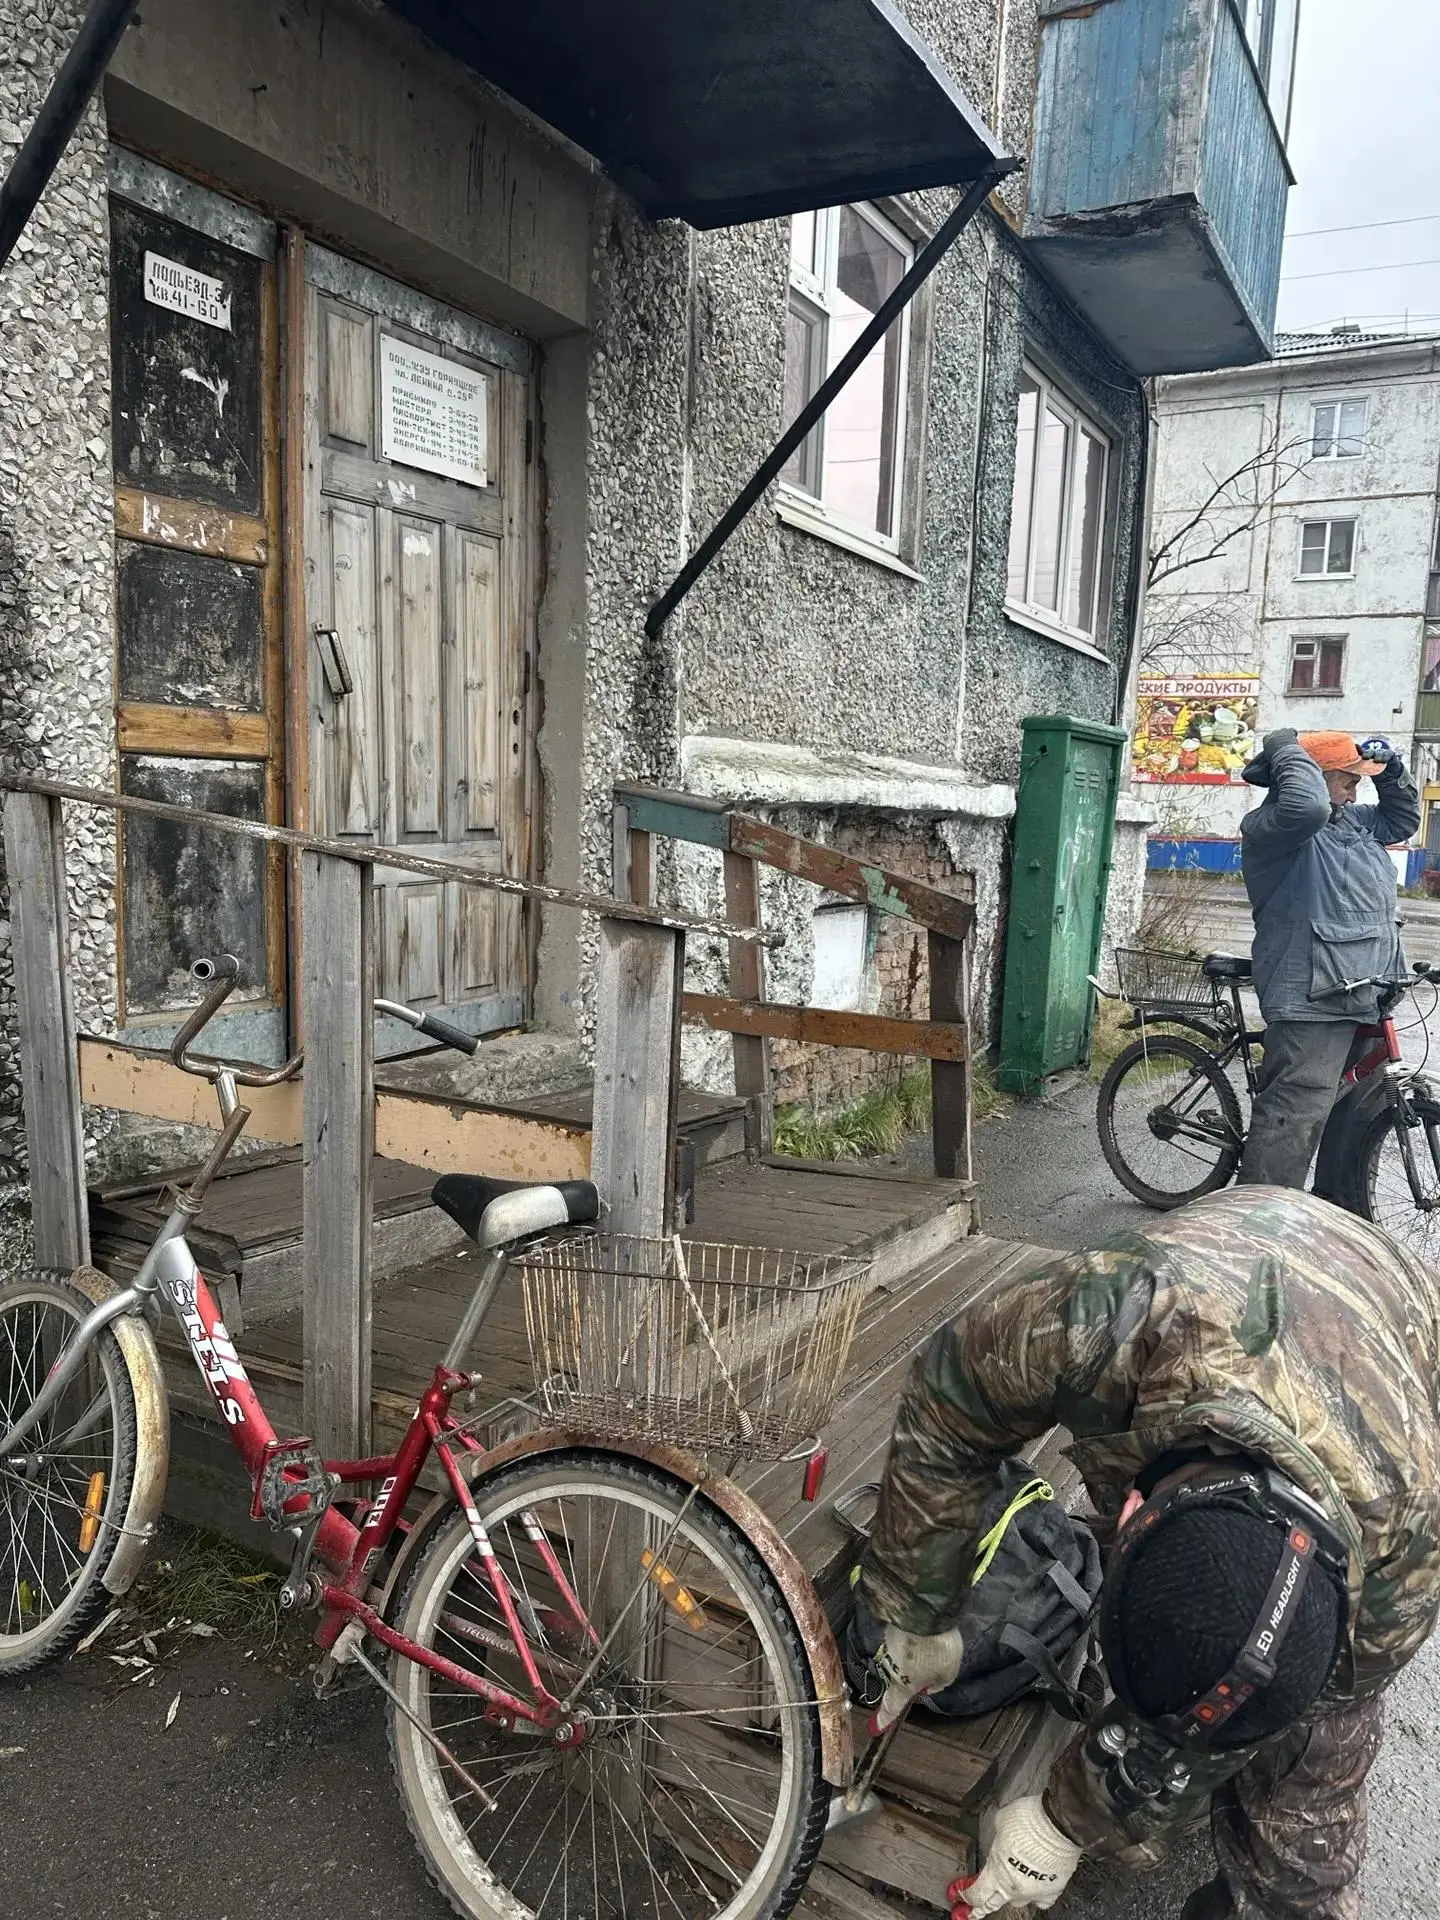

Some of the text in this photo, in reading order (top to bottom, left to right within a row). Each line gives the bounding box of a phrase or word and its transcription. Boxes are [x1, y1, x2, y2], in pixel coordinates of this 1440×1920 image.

[392, 395, 431, 416] МАСТЕРА
[392, 405, 446, 431] ПАСПОРТИСТ
[1175, 682, 1252, 695] ПРОДУКТЫ
[167, 1279, 246, 1425] STELS
[1256, 1554, 1302, 1657] ED HEADLIGHT
